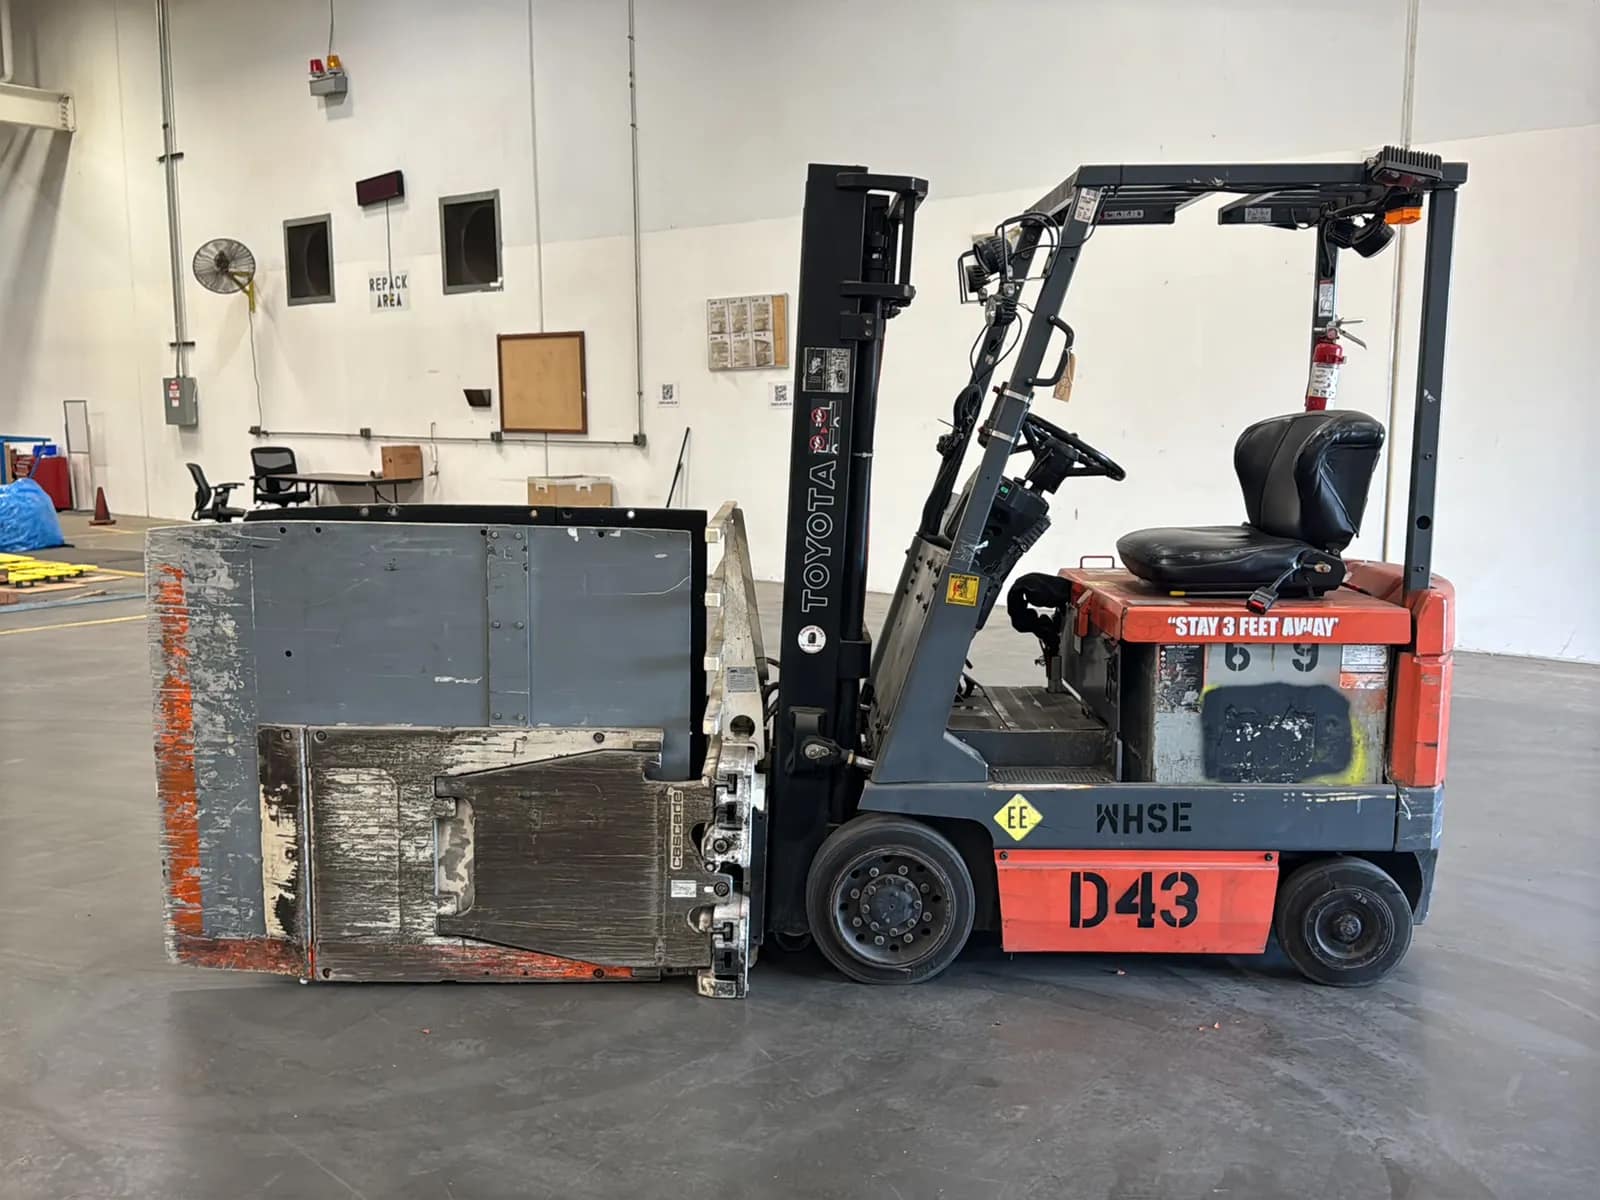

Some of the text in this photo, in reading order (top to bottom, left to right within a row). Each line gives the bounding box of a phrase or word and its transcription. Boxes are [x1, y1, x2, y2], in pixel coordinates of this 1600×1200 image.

[369, 274, 407, 292] REPACK
[377, 293, 402, 308] AREA
[801, 460, 837, 613] TOYOTA
[1223, 616, 1235, 637] 3
[1239, 616, 1280, 637] FEET
[1224, 644, 1250, 672] 6
[1292, 644, 1320, 672] 9
[671, 790, 684, 870] cascade
[1007, 806, 1028, 830] EE
[1096, 803, 1192, 834] WHSE
[1069, 871, 1200, 929] D43
